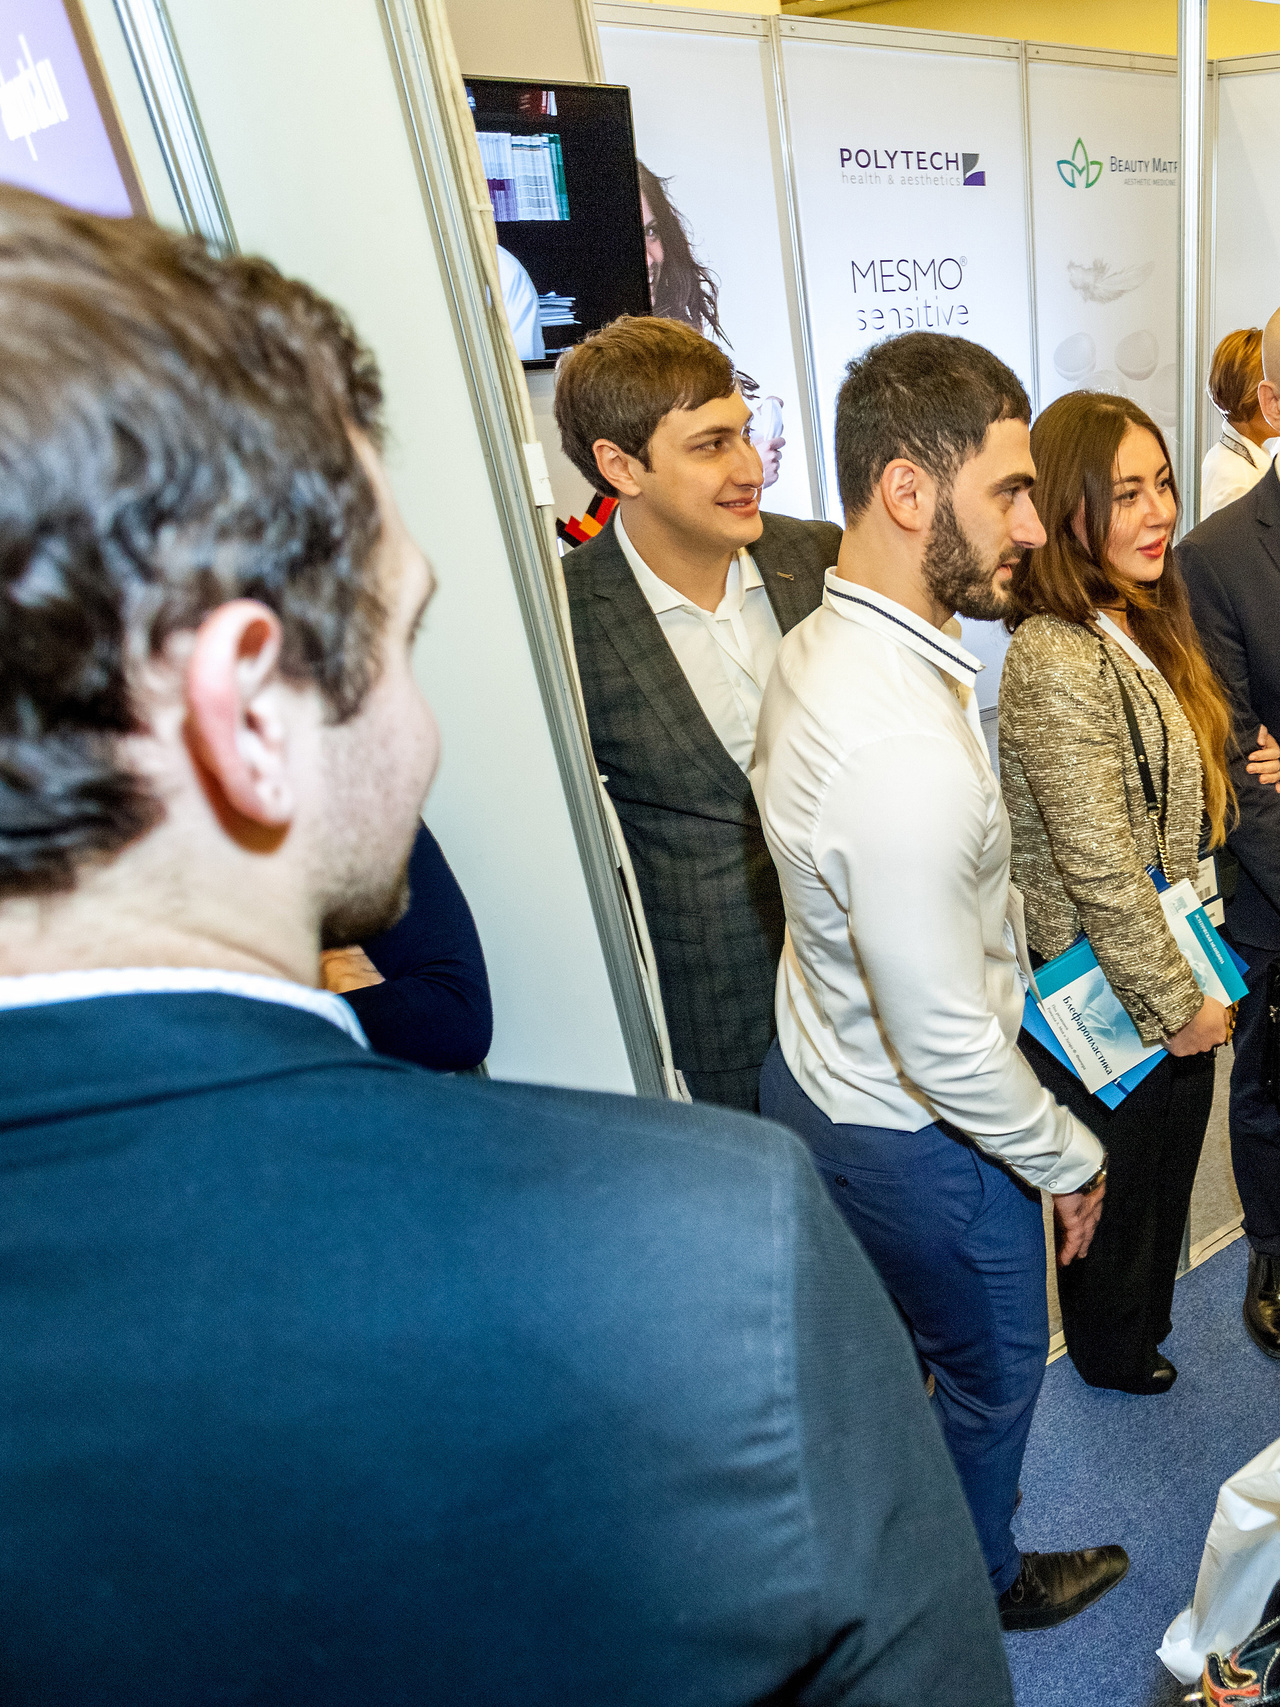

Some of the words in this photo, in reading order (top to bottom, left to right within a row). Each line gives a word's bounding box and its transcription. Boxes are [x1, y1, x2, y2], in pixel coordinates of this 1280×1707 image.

[839, 148, 960, 171] POLYTECH
[842, 171, 881, 185] health
[887, 174, 895, 185] &
[900, 172, 961, 186] aesthetics
[857, 295, 969, 331] sensitive
[1062, 995, 1113, 1075] Блефаропластика
